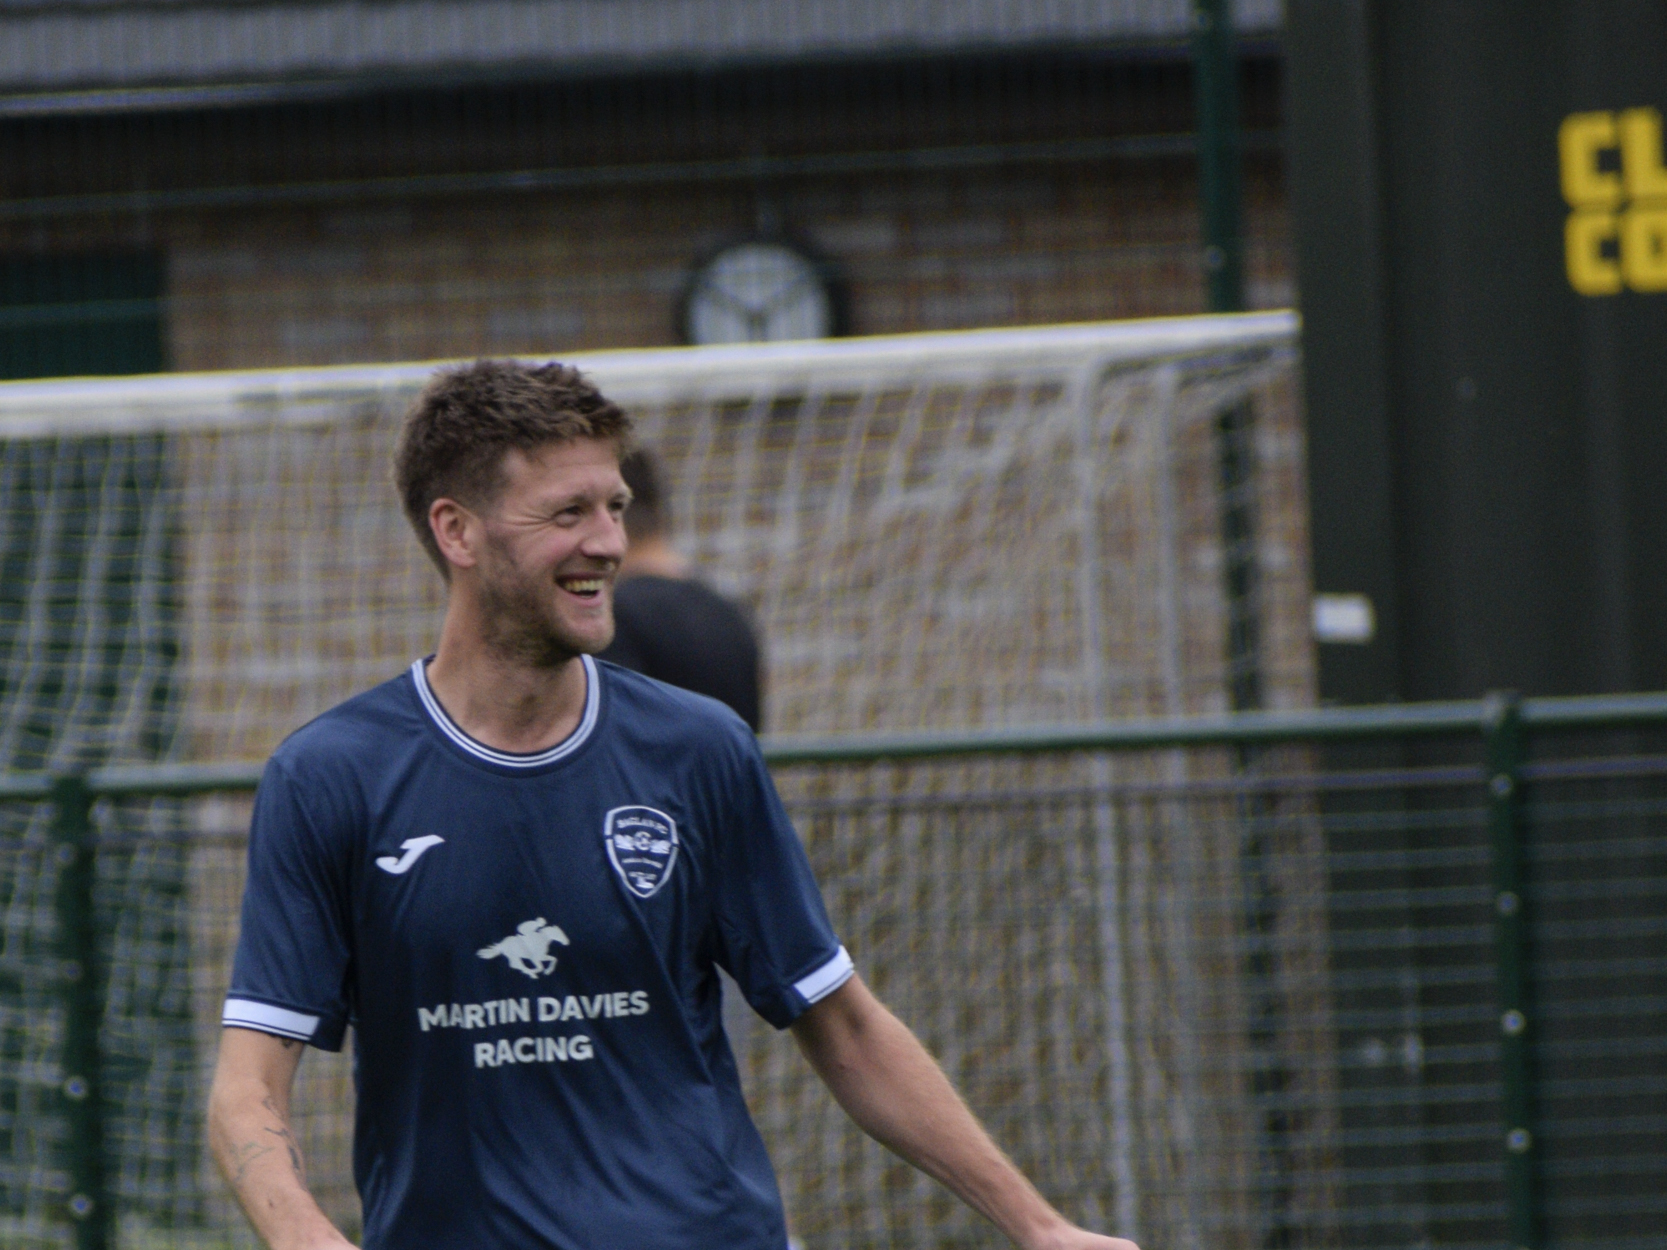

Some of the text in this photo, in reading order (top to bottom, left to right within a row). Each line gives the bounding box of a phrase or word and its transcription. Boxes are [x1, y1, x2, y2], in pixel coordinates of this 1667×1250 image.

[417, 990, 650, 1032] MARTIN DAVIES
[474, 1034, 595, 1069] RACING
